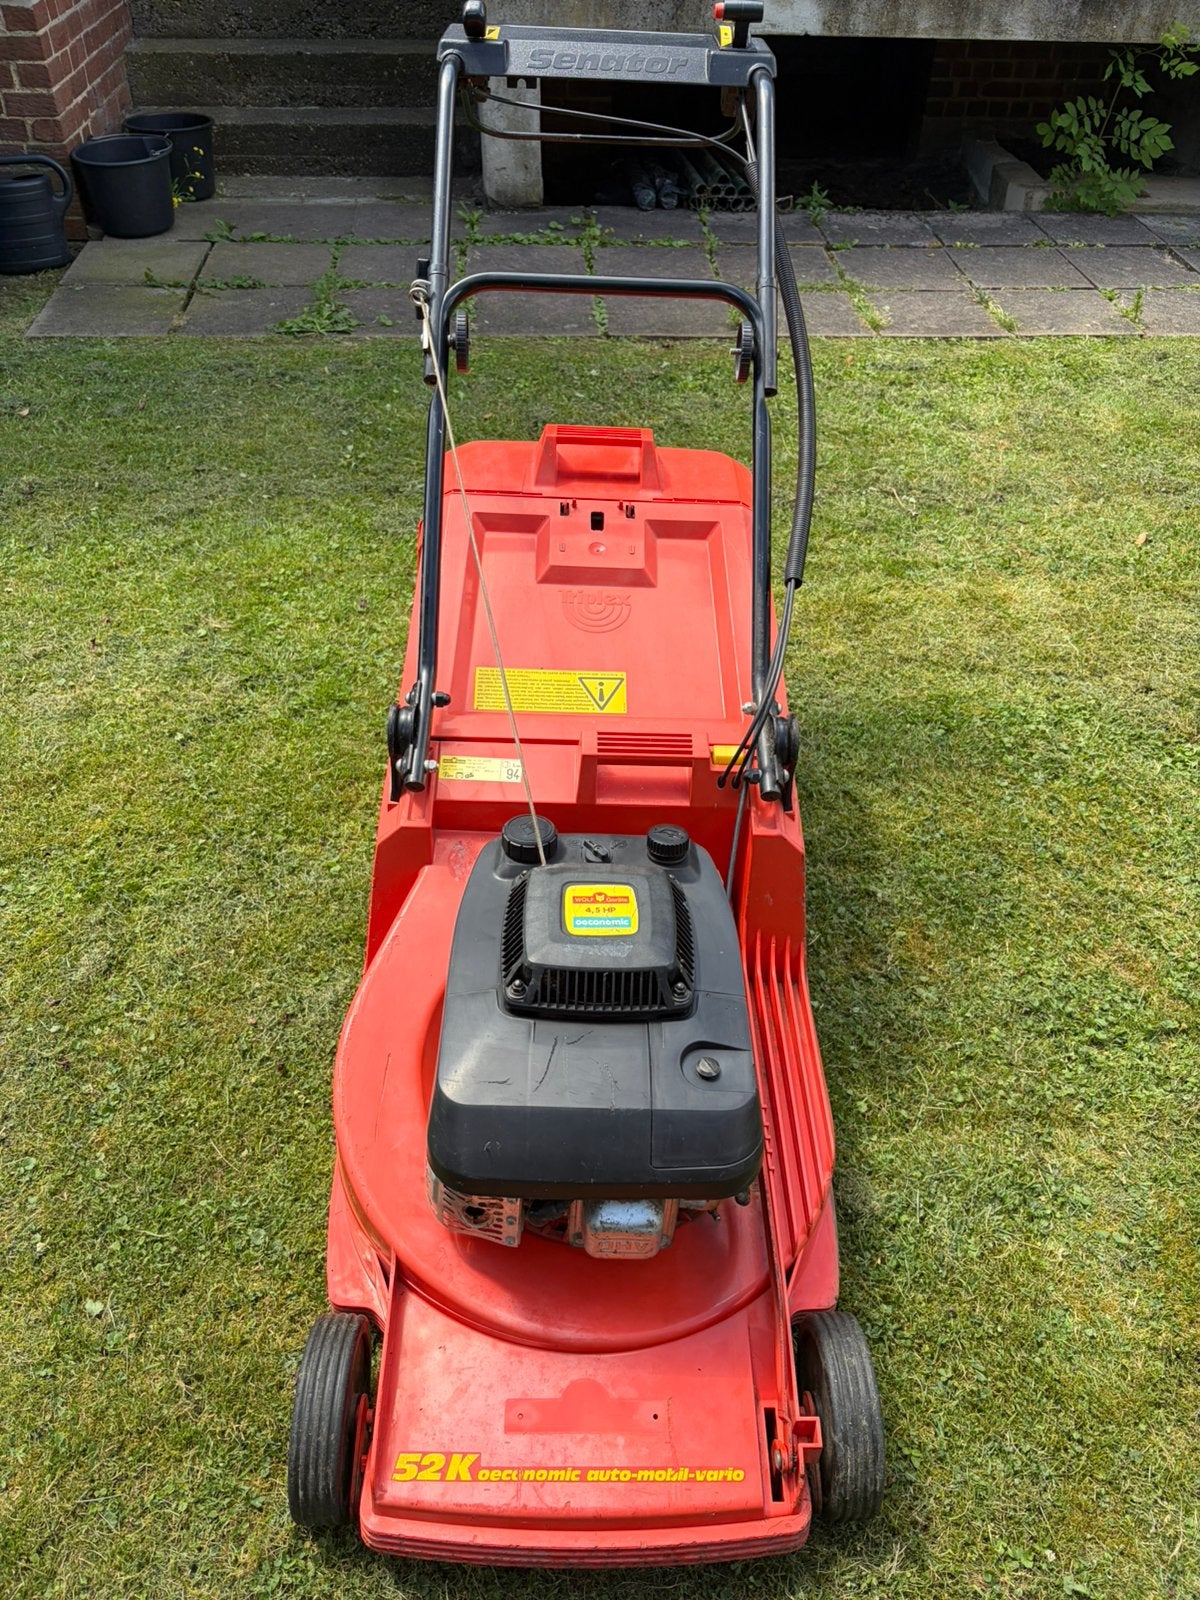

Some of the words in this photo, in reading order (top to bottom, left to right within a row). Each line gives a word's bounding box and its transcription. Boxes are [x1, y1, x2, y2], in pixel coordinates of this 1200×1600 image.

[527, 48, 689, 74] Senator
[506, 768, 520, 780] 94
[585, 906, 601, 914] 4,5
[575, 918, 630, 926] oeconomic
[586, 1467, 746, 1482] auto-mobil-vario
